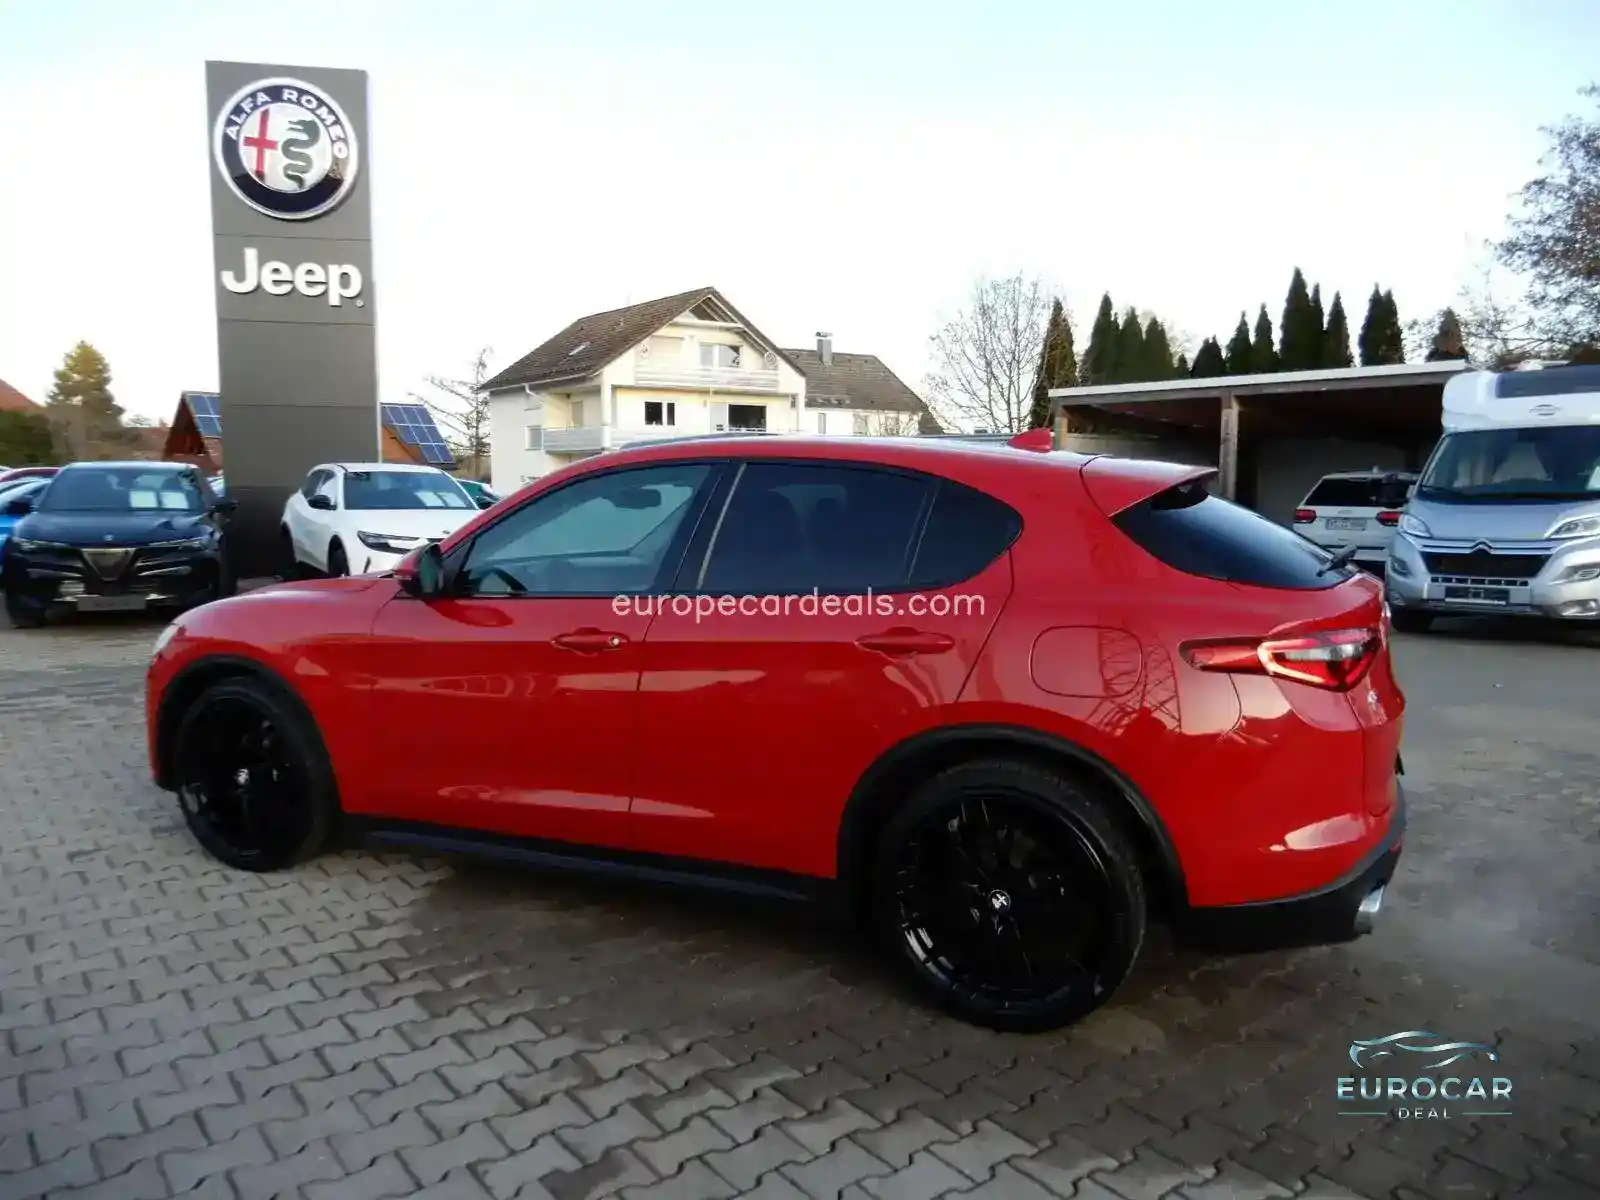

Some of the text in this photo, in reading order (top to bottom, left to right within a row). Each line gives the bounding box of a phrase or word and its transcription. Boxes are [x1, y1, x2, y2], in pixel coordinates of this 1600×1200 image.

[226, 88, 349, 159] ALFA ROMEO
[220, 247, 362, 307] Jeep
